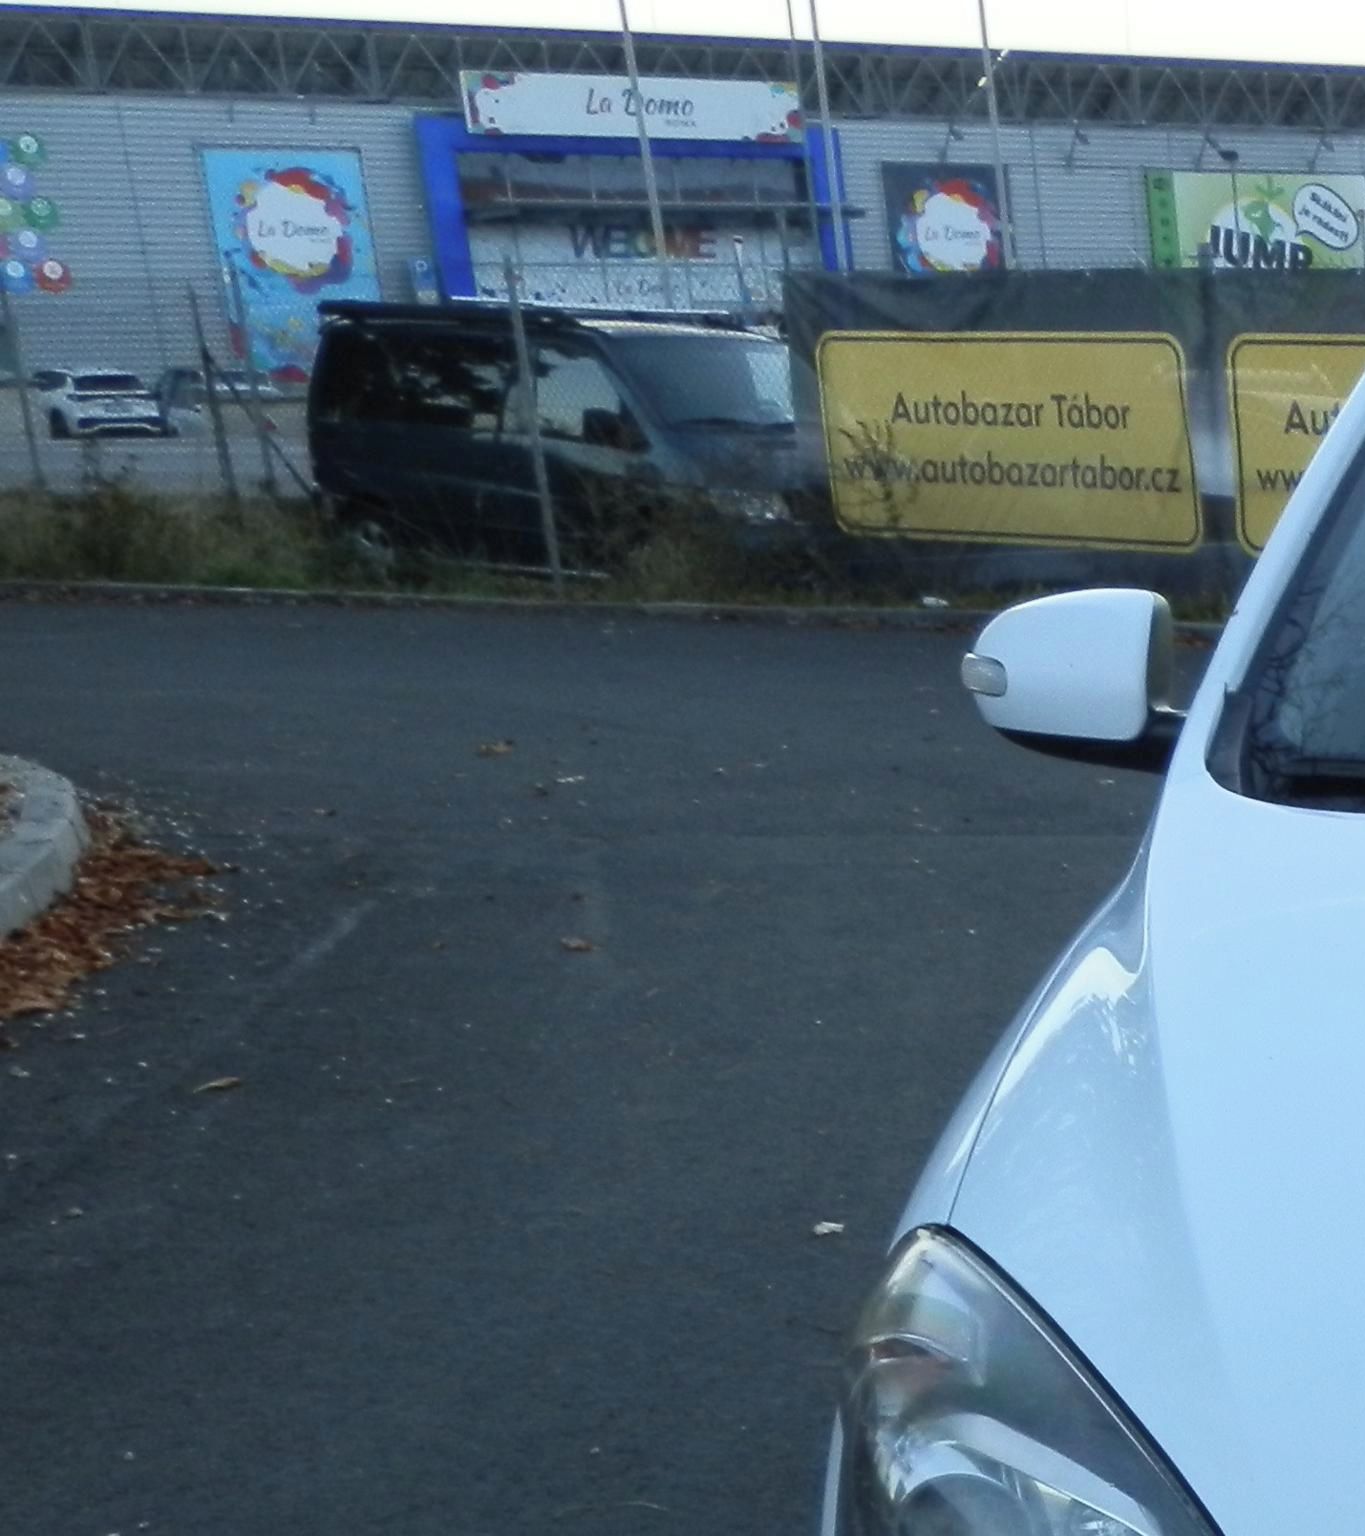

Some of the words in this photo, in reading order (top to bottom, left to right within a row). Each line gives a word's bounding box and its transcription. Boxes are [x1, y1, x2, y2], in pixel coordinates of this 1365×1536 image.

[586, 88, 612, 115] La
[1208, 224, 1313, 269] JUMP
[891, 391, 1045, 428] Autobazar
[1050, 392, 1131, 430] Tábor
[843, 451, 1183, 493] www.autobazartabor.cz
